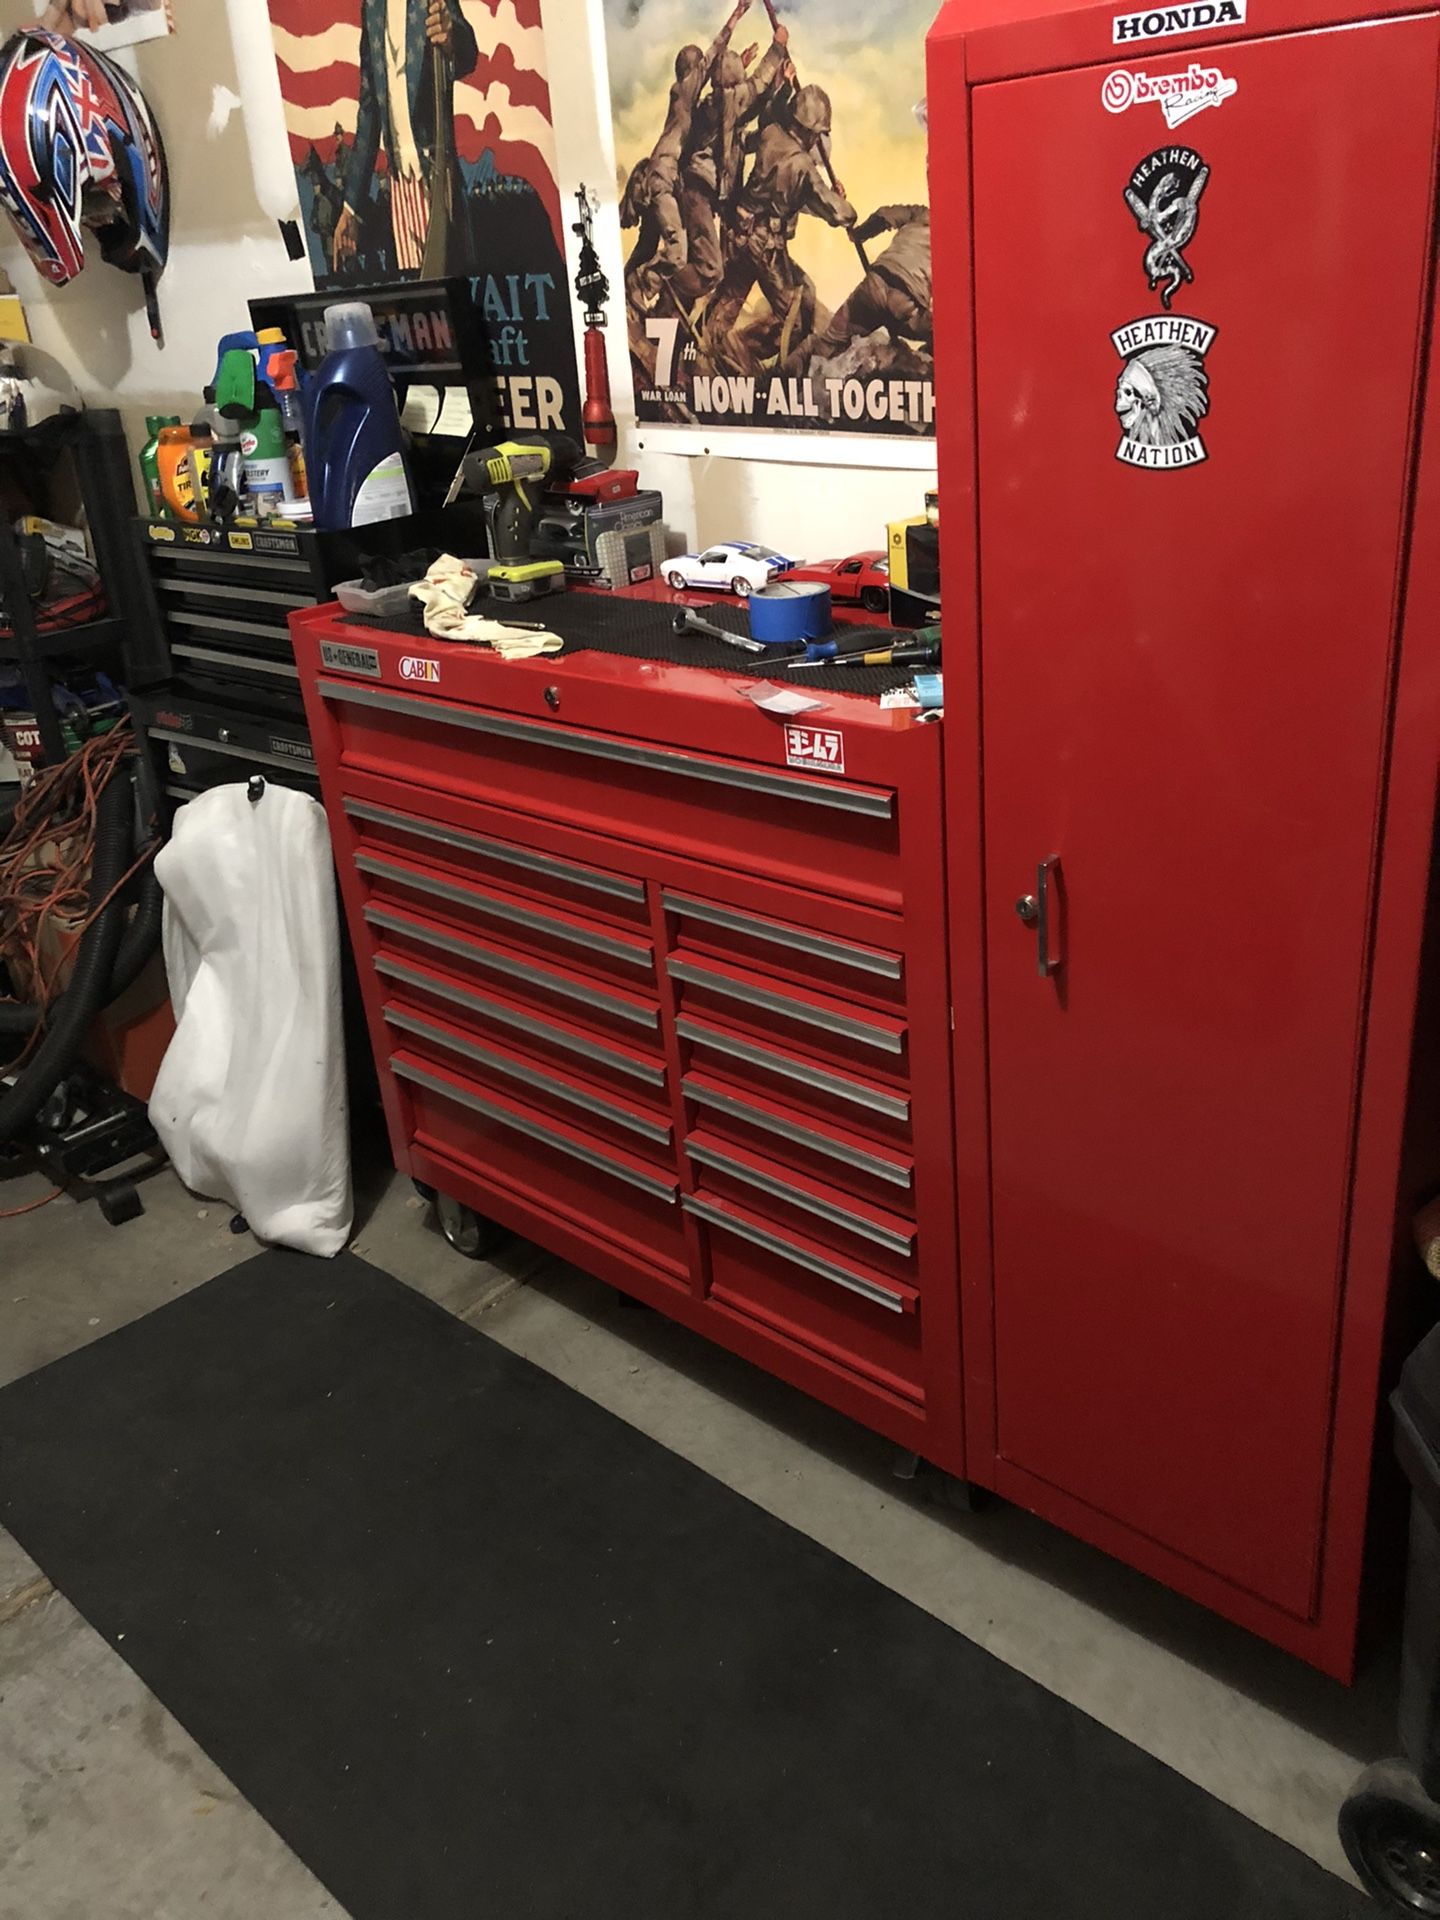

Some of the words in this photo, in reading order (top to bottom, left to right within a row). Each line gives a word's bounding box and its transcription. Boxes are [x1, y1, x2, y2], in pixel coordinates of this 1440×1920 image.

[1116, 2, 1242, 41] HONDA
[1136, 67, 1218, 99] brembo
[1132, 149, 1200, 188] HEATHEN
[1117, 320, 1209, 352] HEATHEN
[683, 341, 698, 361] th
[641, 389, 662, 402] WAR
[664, 390, 687, 403] LOAN
[825, 378, 936, 423] TOGETH
[1123, 441, 1199, 466] NATION
[177, 480, 192, 492] TIR
[401, 658, 440, 680] CABIN
